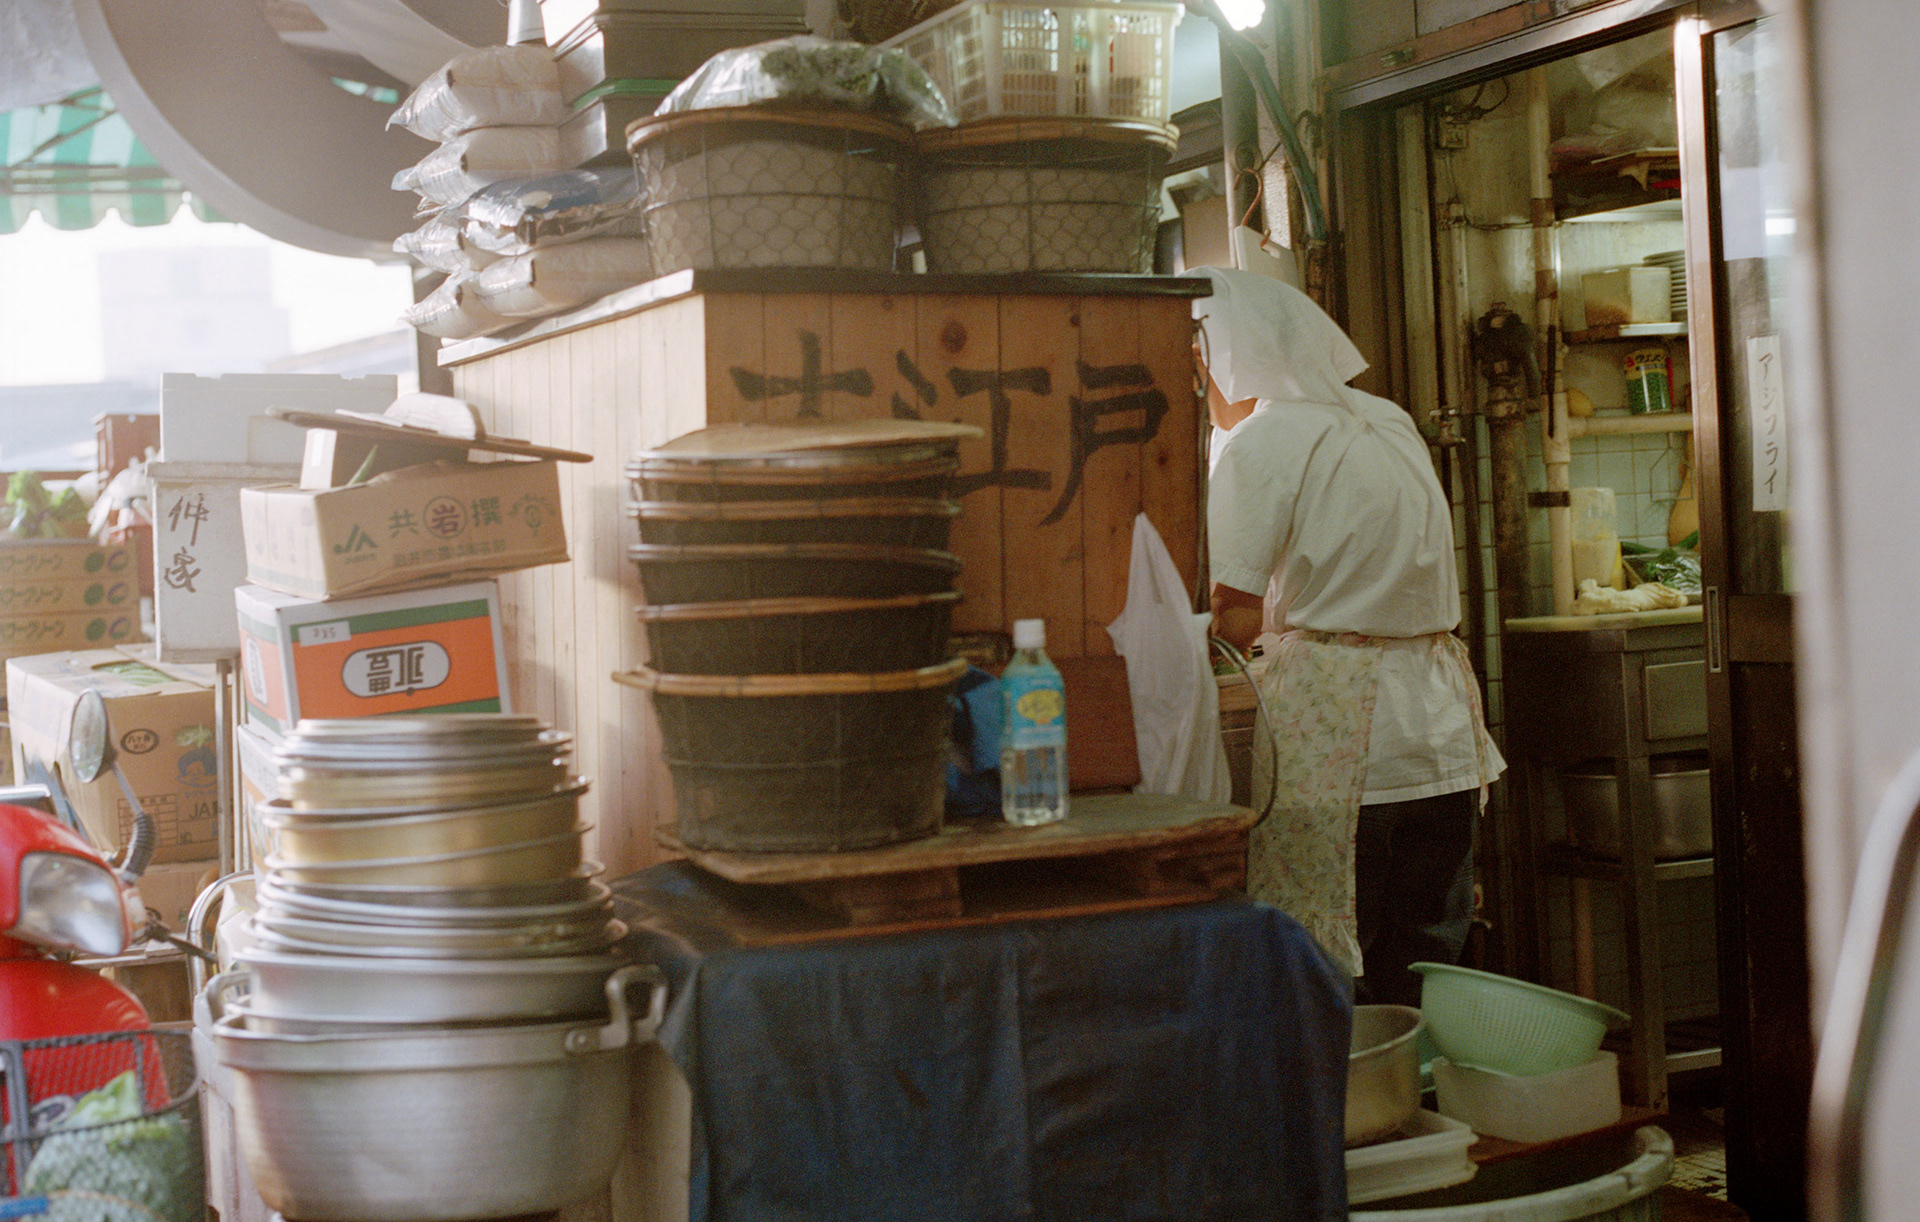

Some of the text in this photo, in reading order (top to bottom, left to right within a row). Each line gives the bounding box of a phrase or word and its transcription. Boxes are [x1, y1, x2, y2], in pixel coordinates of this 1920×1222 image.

[1758, 352, 1779, 495] アジフライ
